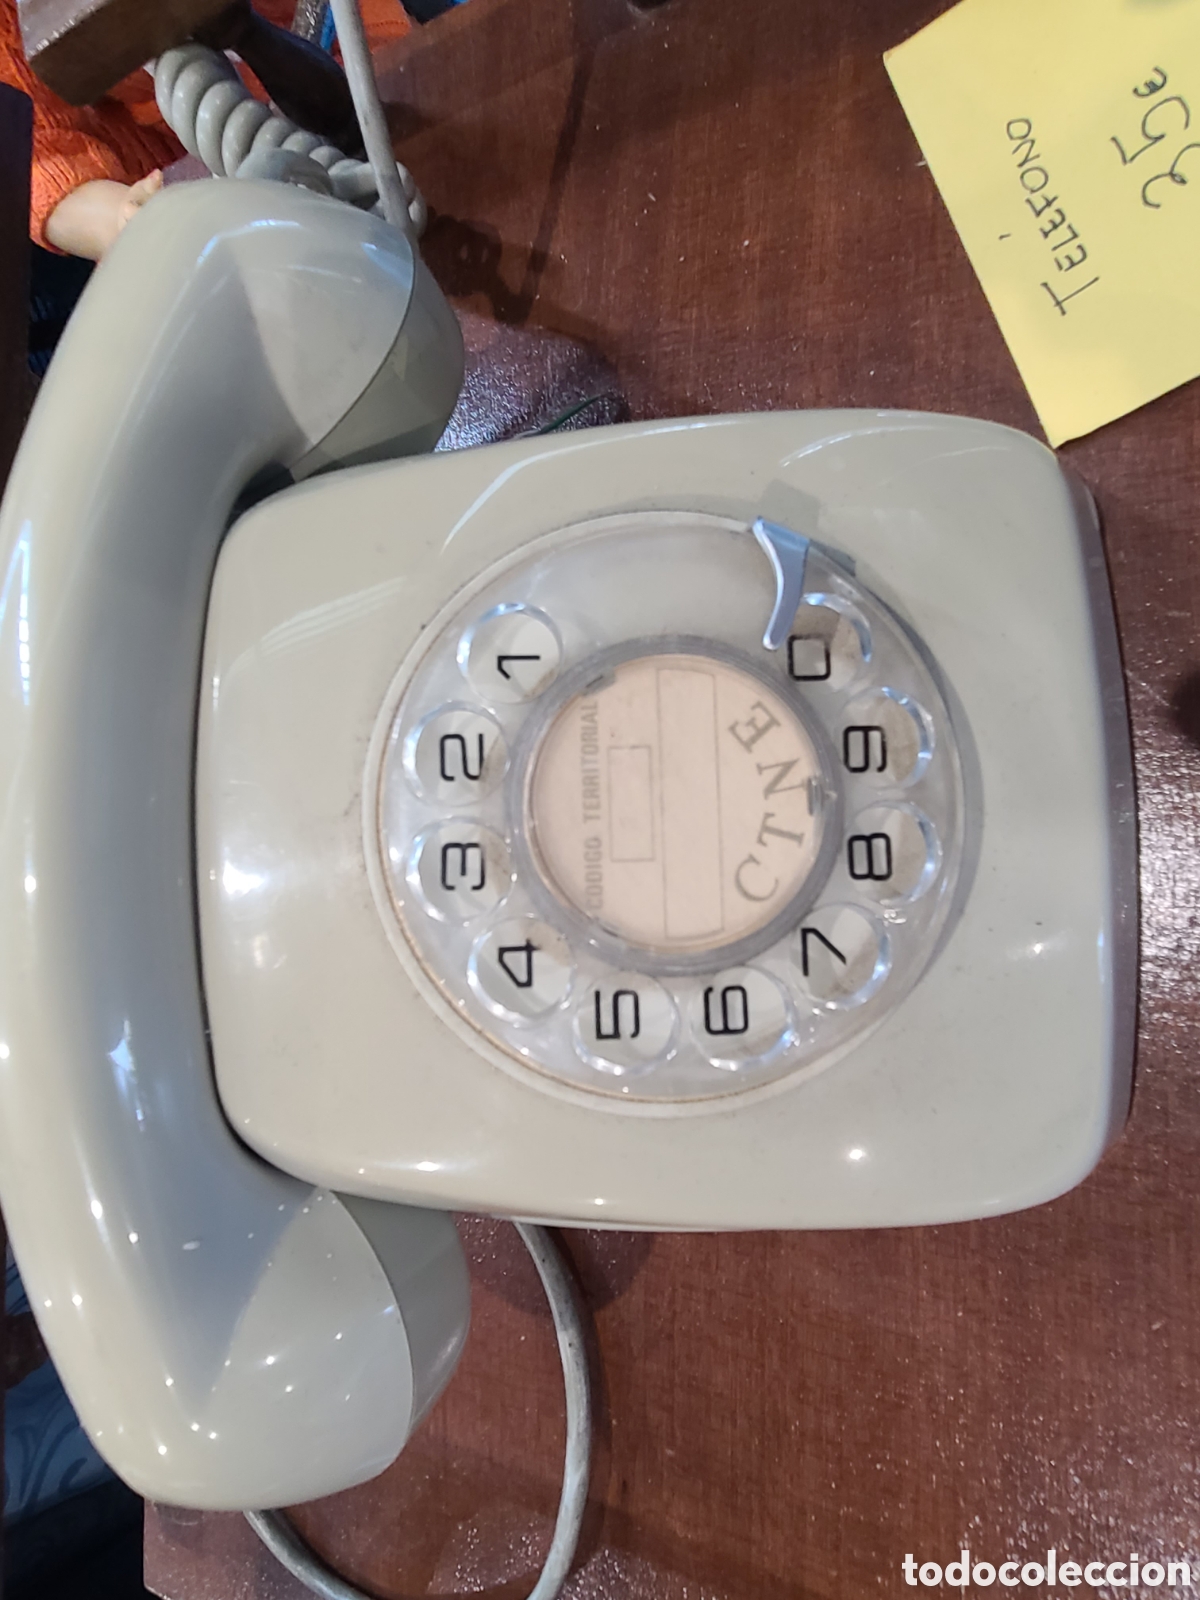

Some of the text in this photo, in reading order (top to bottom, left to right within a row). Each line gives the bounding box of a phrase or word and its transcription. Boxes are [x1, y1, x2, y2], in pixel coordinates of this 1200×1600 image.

[497, 655, 541, 679] 1
[439, 733, 484, 782] 2
[842, 725, 887, 773] 9
[580, 702, 604, 910] CODIGO TERRITORIAL
[727, 700, 809, 903] CTNE
[440, 842, 486, 891] 3
[847, 832, 893, 881] 8
[498, 938, 541, 988] 4
[800, 927, 847, 977] 7
[594, 989, 640, 1040] 5
[703, 985, 749, 1035] 6
